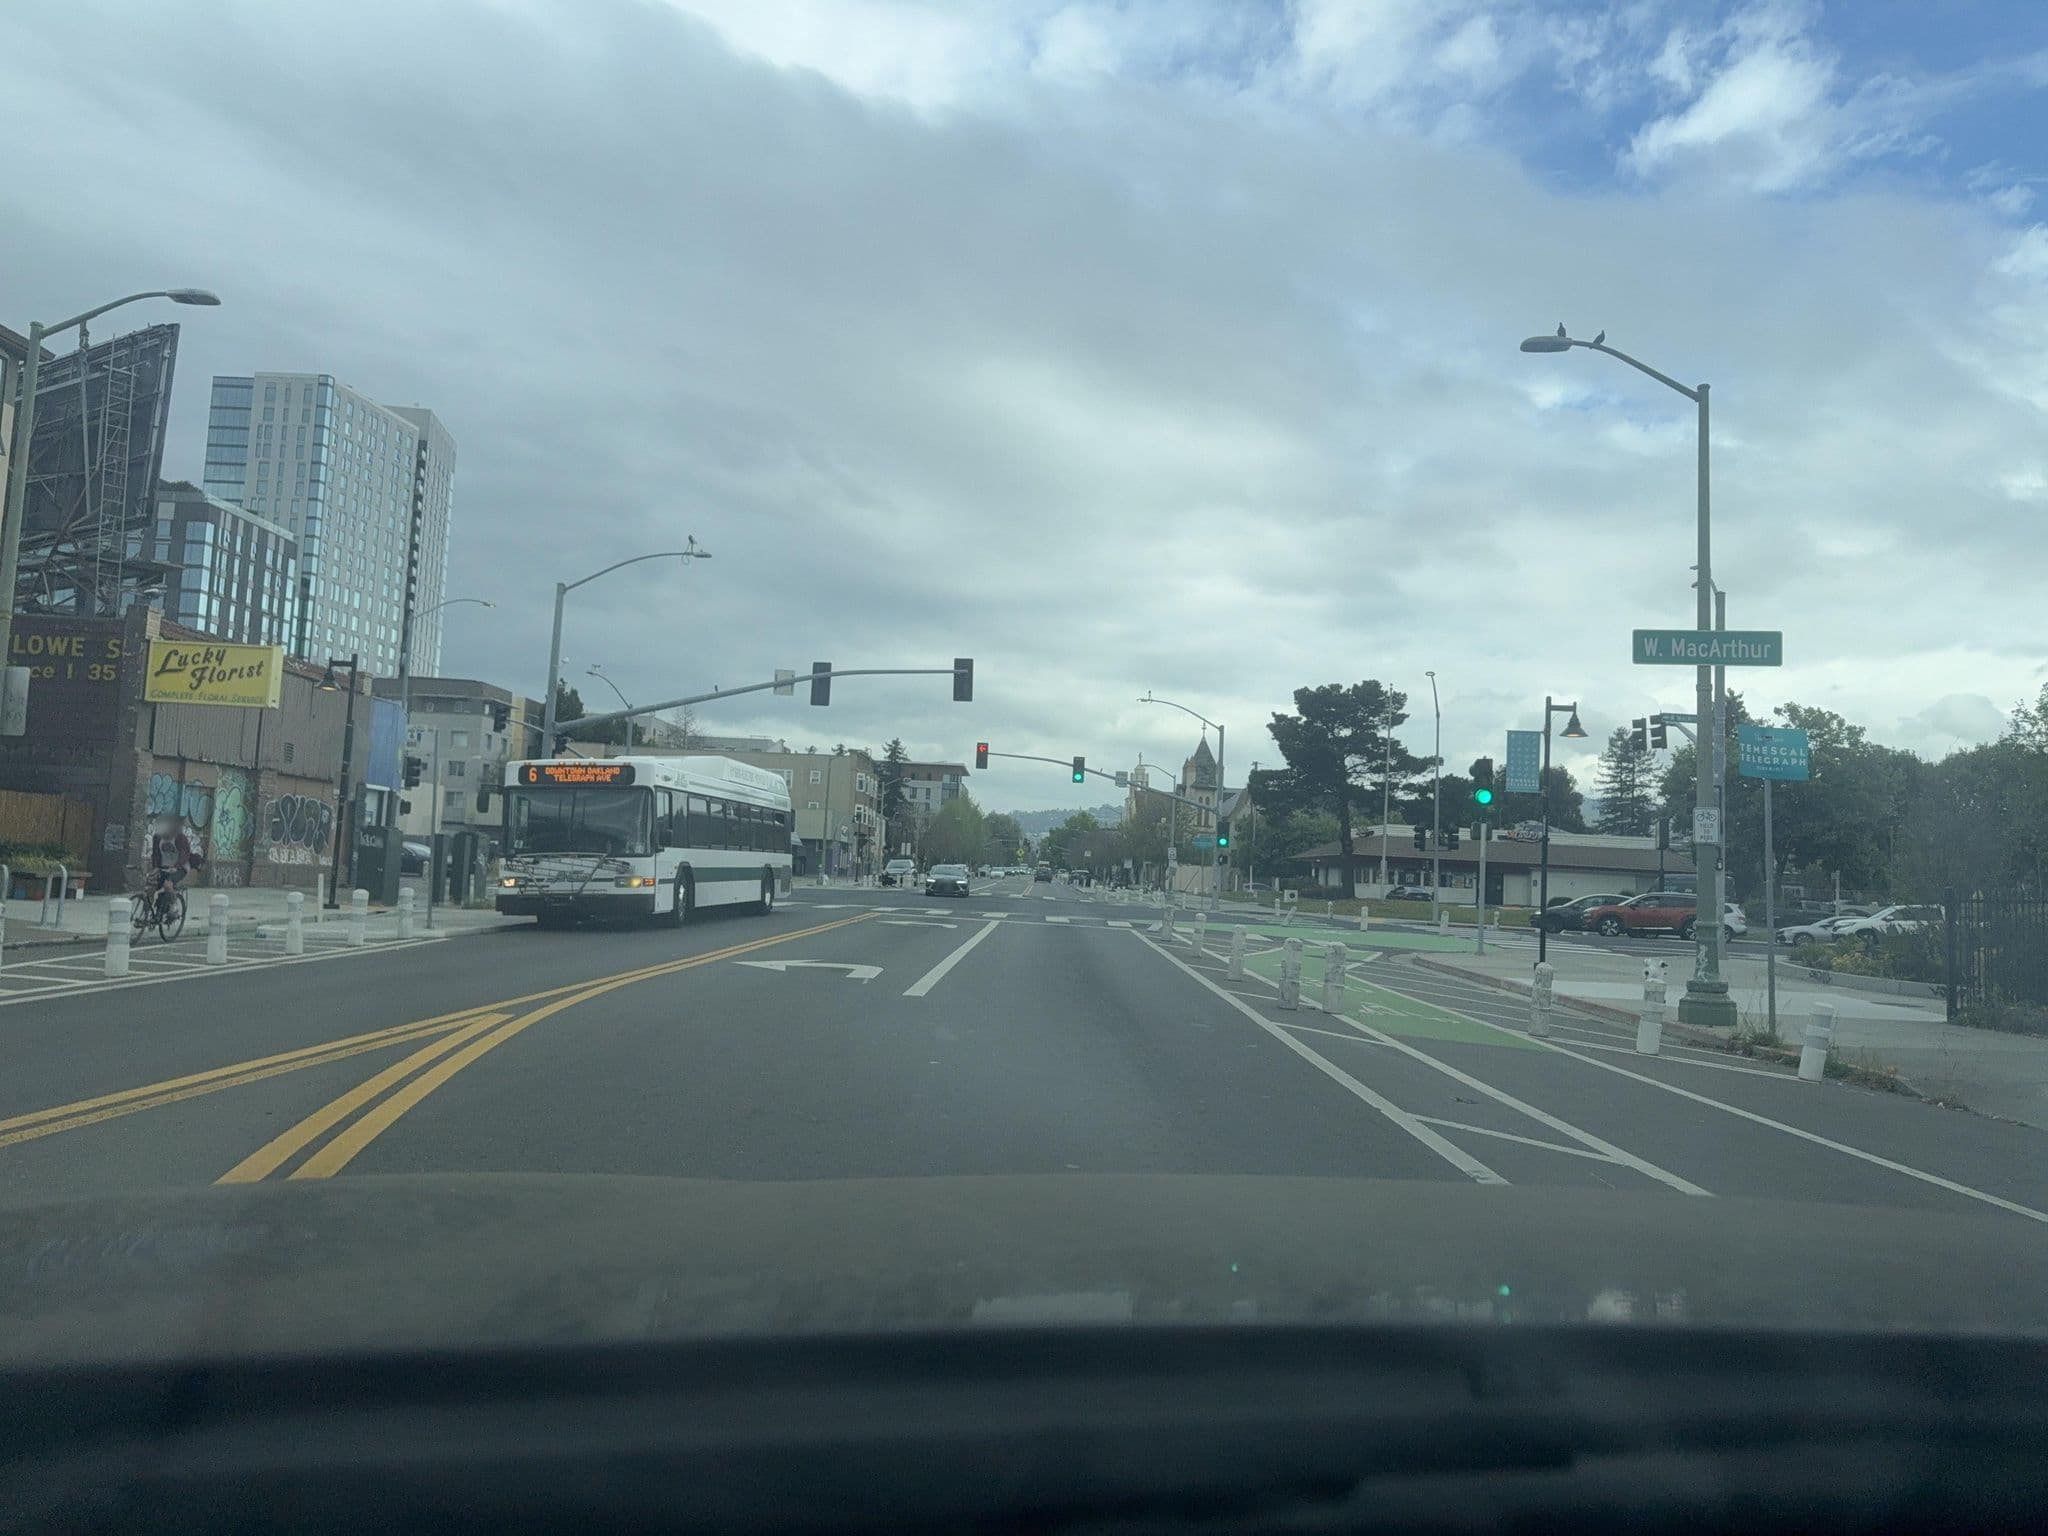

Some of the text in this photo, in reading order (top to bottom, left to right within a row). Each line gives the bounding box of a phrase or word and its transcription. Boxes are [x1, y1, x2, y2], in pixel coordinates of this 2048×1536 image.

[1644, 637, 1772, 659] W. MacArthur
[155, 647, 227, 677] Lucky
[188, 660, 265, 691] Florist
[1739, 743, 1806, 757] TEMESCAL
[1740, 753, 1807, 767] TELEGRAPH
[528, 767, 620, 782] 6 DOWNTOWN OAKLAND
[554, 774, 612, 782] TELEGRAPH AVE
